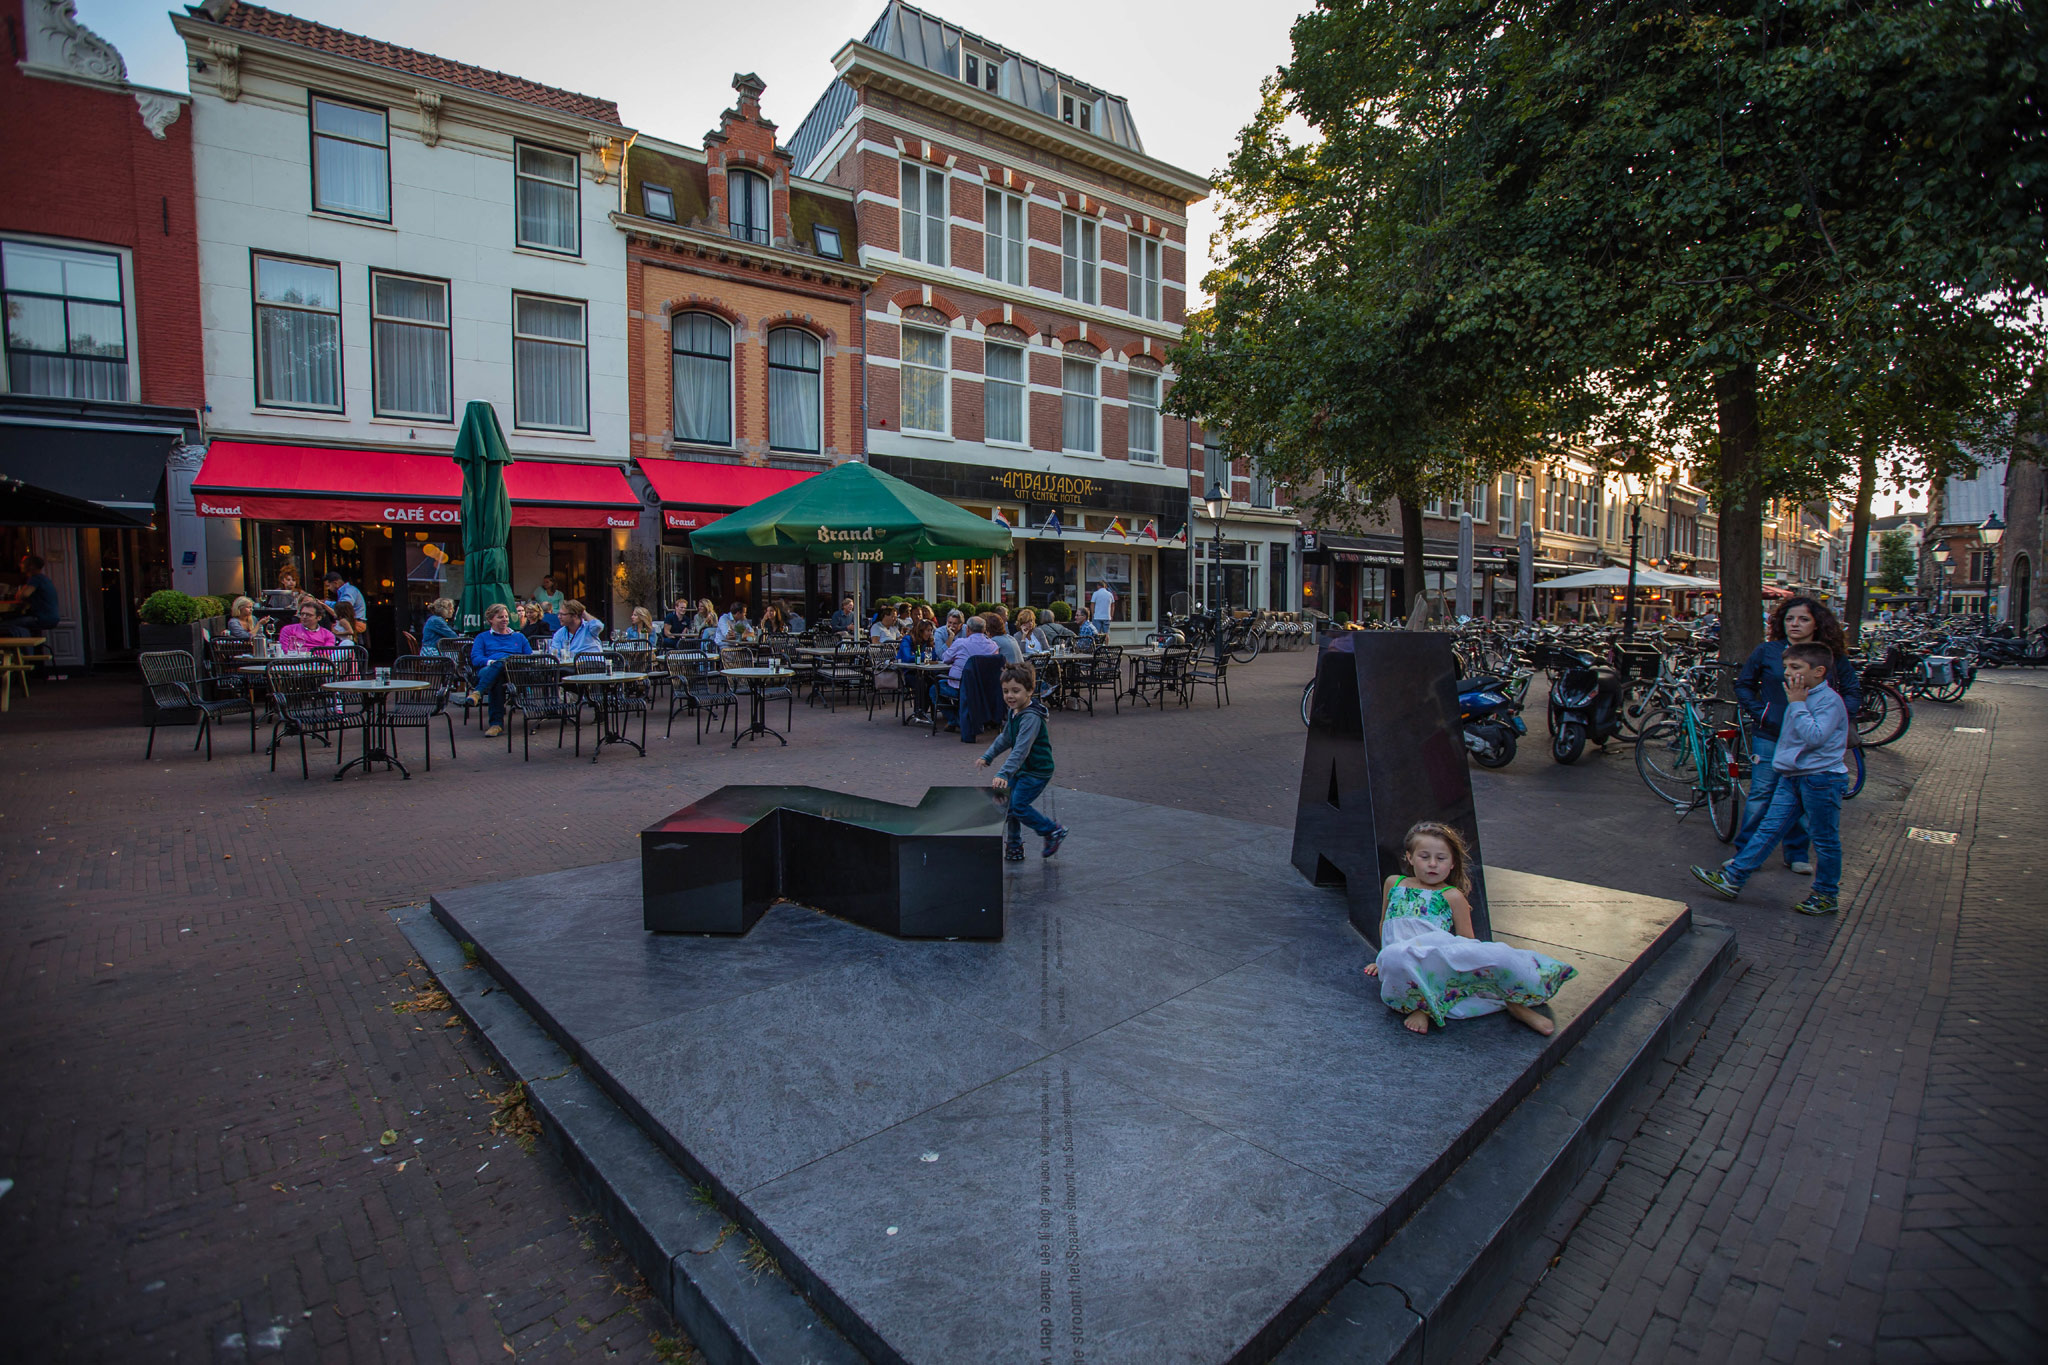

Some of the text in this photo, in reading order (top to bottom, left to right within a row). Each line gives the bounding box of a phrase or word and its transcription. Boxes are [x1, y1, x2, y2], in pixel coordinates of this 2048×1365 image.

[1003, 471, 1093, 496] AMBASSADOR
[1014, 489, 1082, 504] CITY CENTRE HOTEL
[201, 502, 242, 515] Brand
[383, 507, 424, 522] CAFÉ
[607, 516, 635, 527] Brand
[668, 515, 696, 527] Brand
[817, 525, 874, 543] Brand
[1044, 575, 1055, 585] 20
[1039, 1160, 1050, 1182] open
[1040, 1209, 1052, 1228] doe
[1065, 1214, 1081, 1259] Spaarne
[1040, 1244, 1051, 1265] een
[1067, 1263, 1080, 1283] het
[1040, 1270, 1054, 1314] andere
[1040, 1318, 1054, 1351] deur
